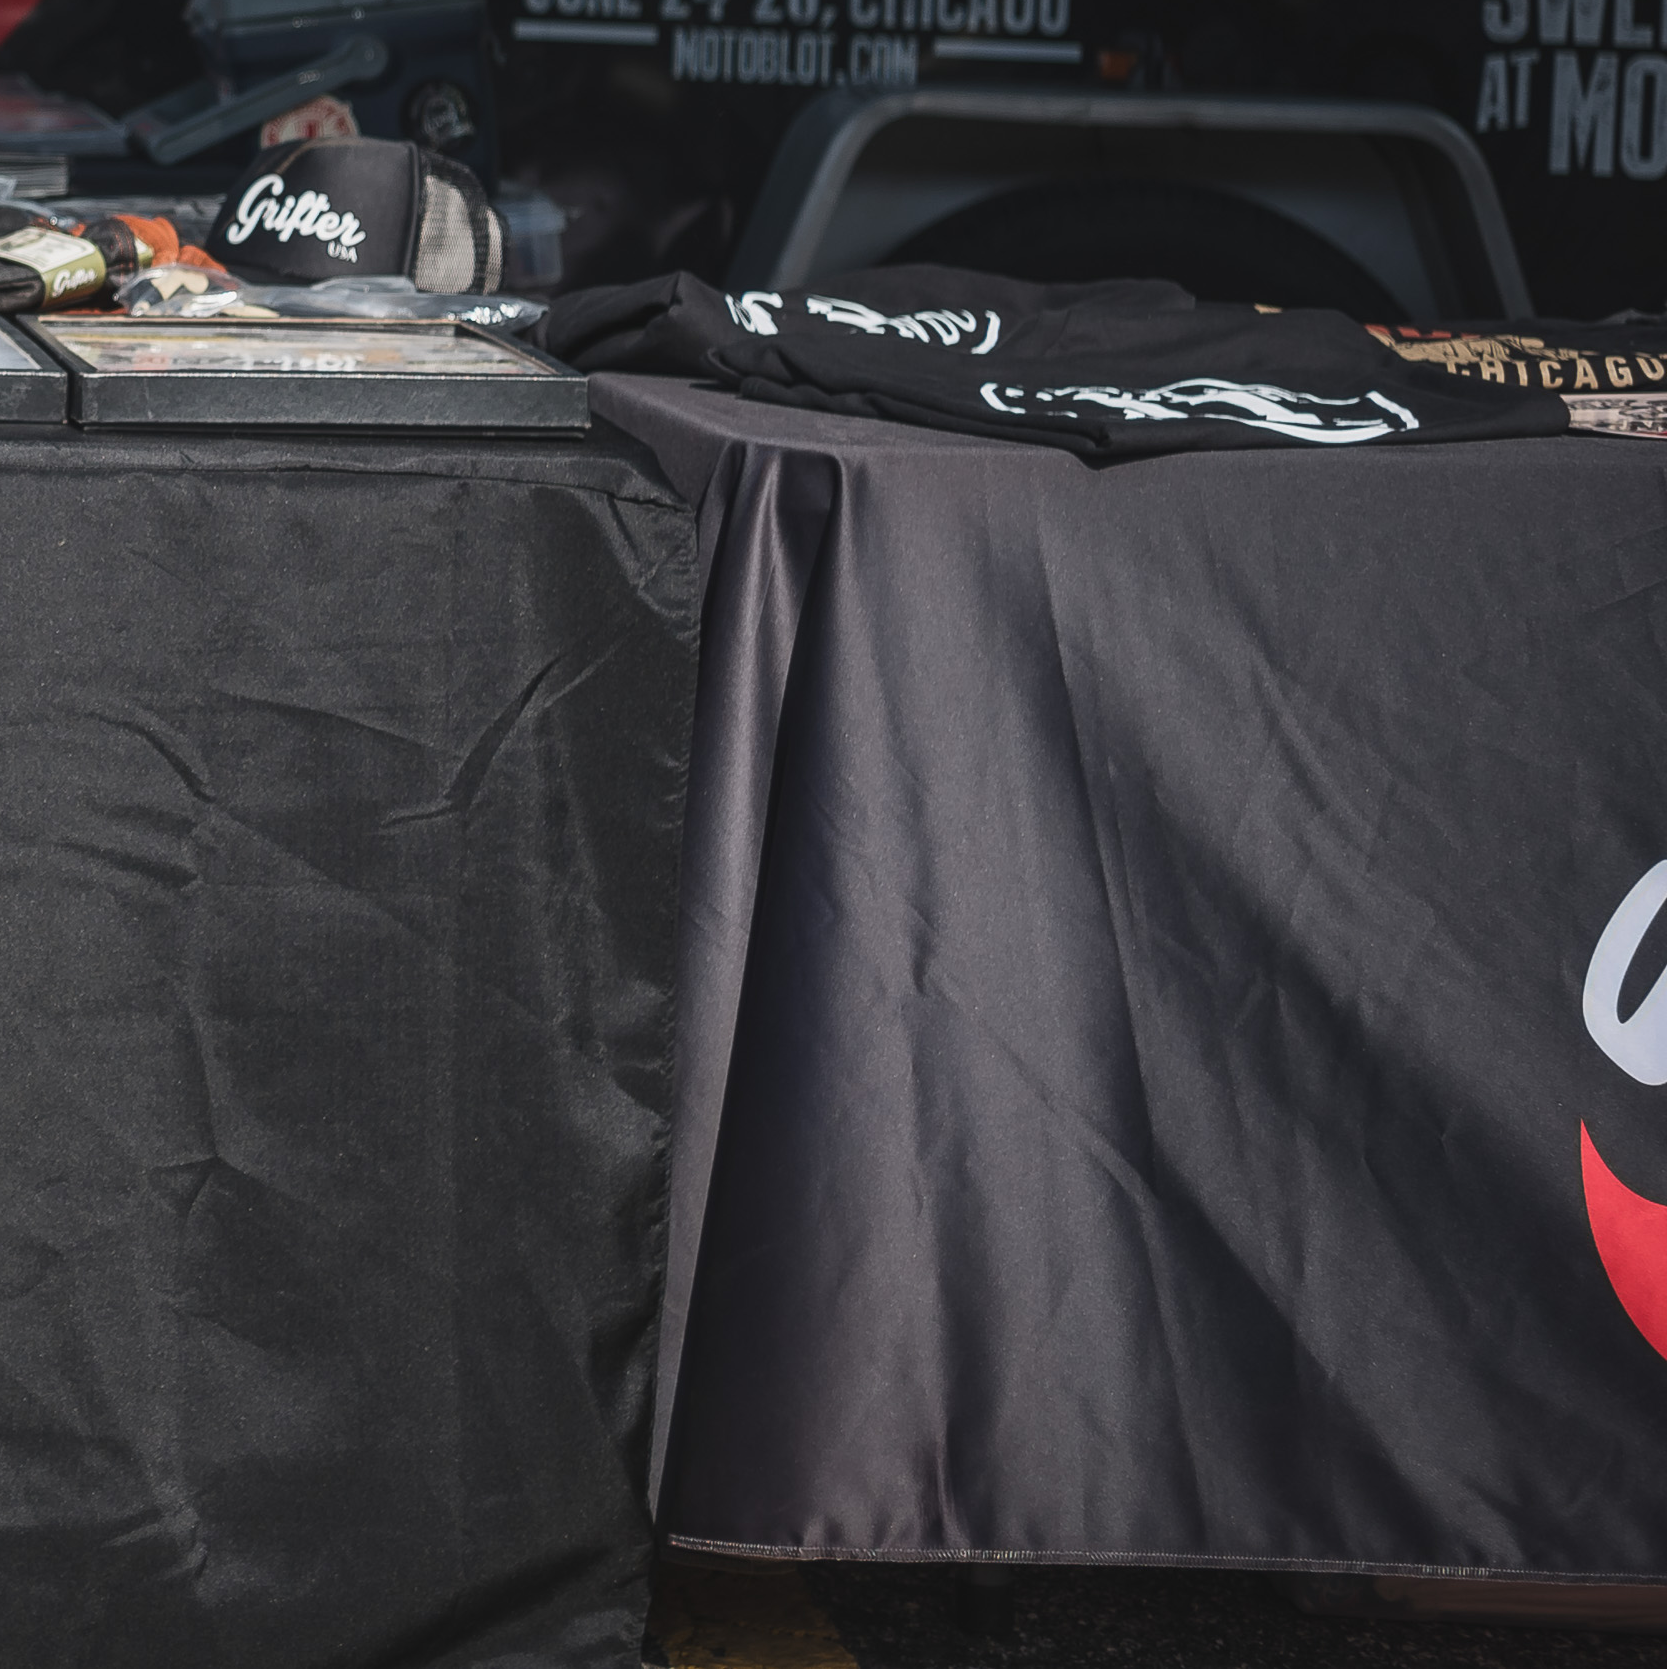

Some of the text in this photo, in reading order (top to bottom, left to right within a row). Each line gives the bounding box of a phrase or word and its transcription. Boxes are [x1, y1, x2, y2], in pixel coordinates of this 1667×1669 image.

[673, 28, 919, 86] MOTOBLOT.COM
[1476, 49, 1539, 132] AT
[226, 172, 367, 247] Grifter
